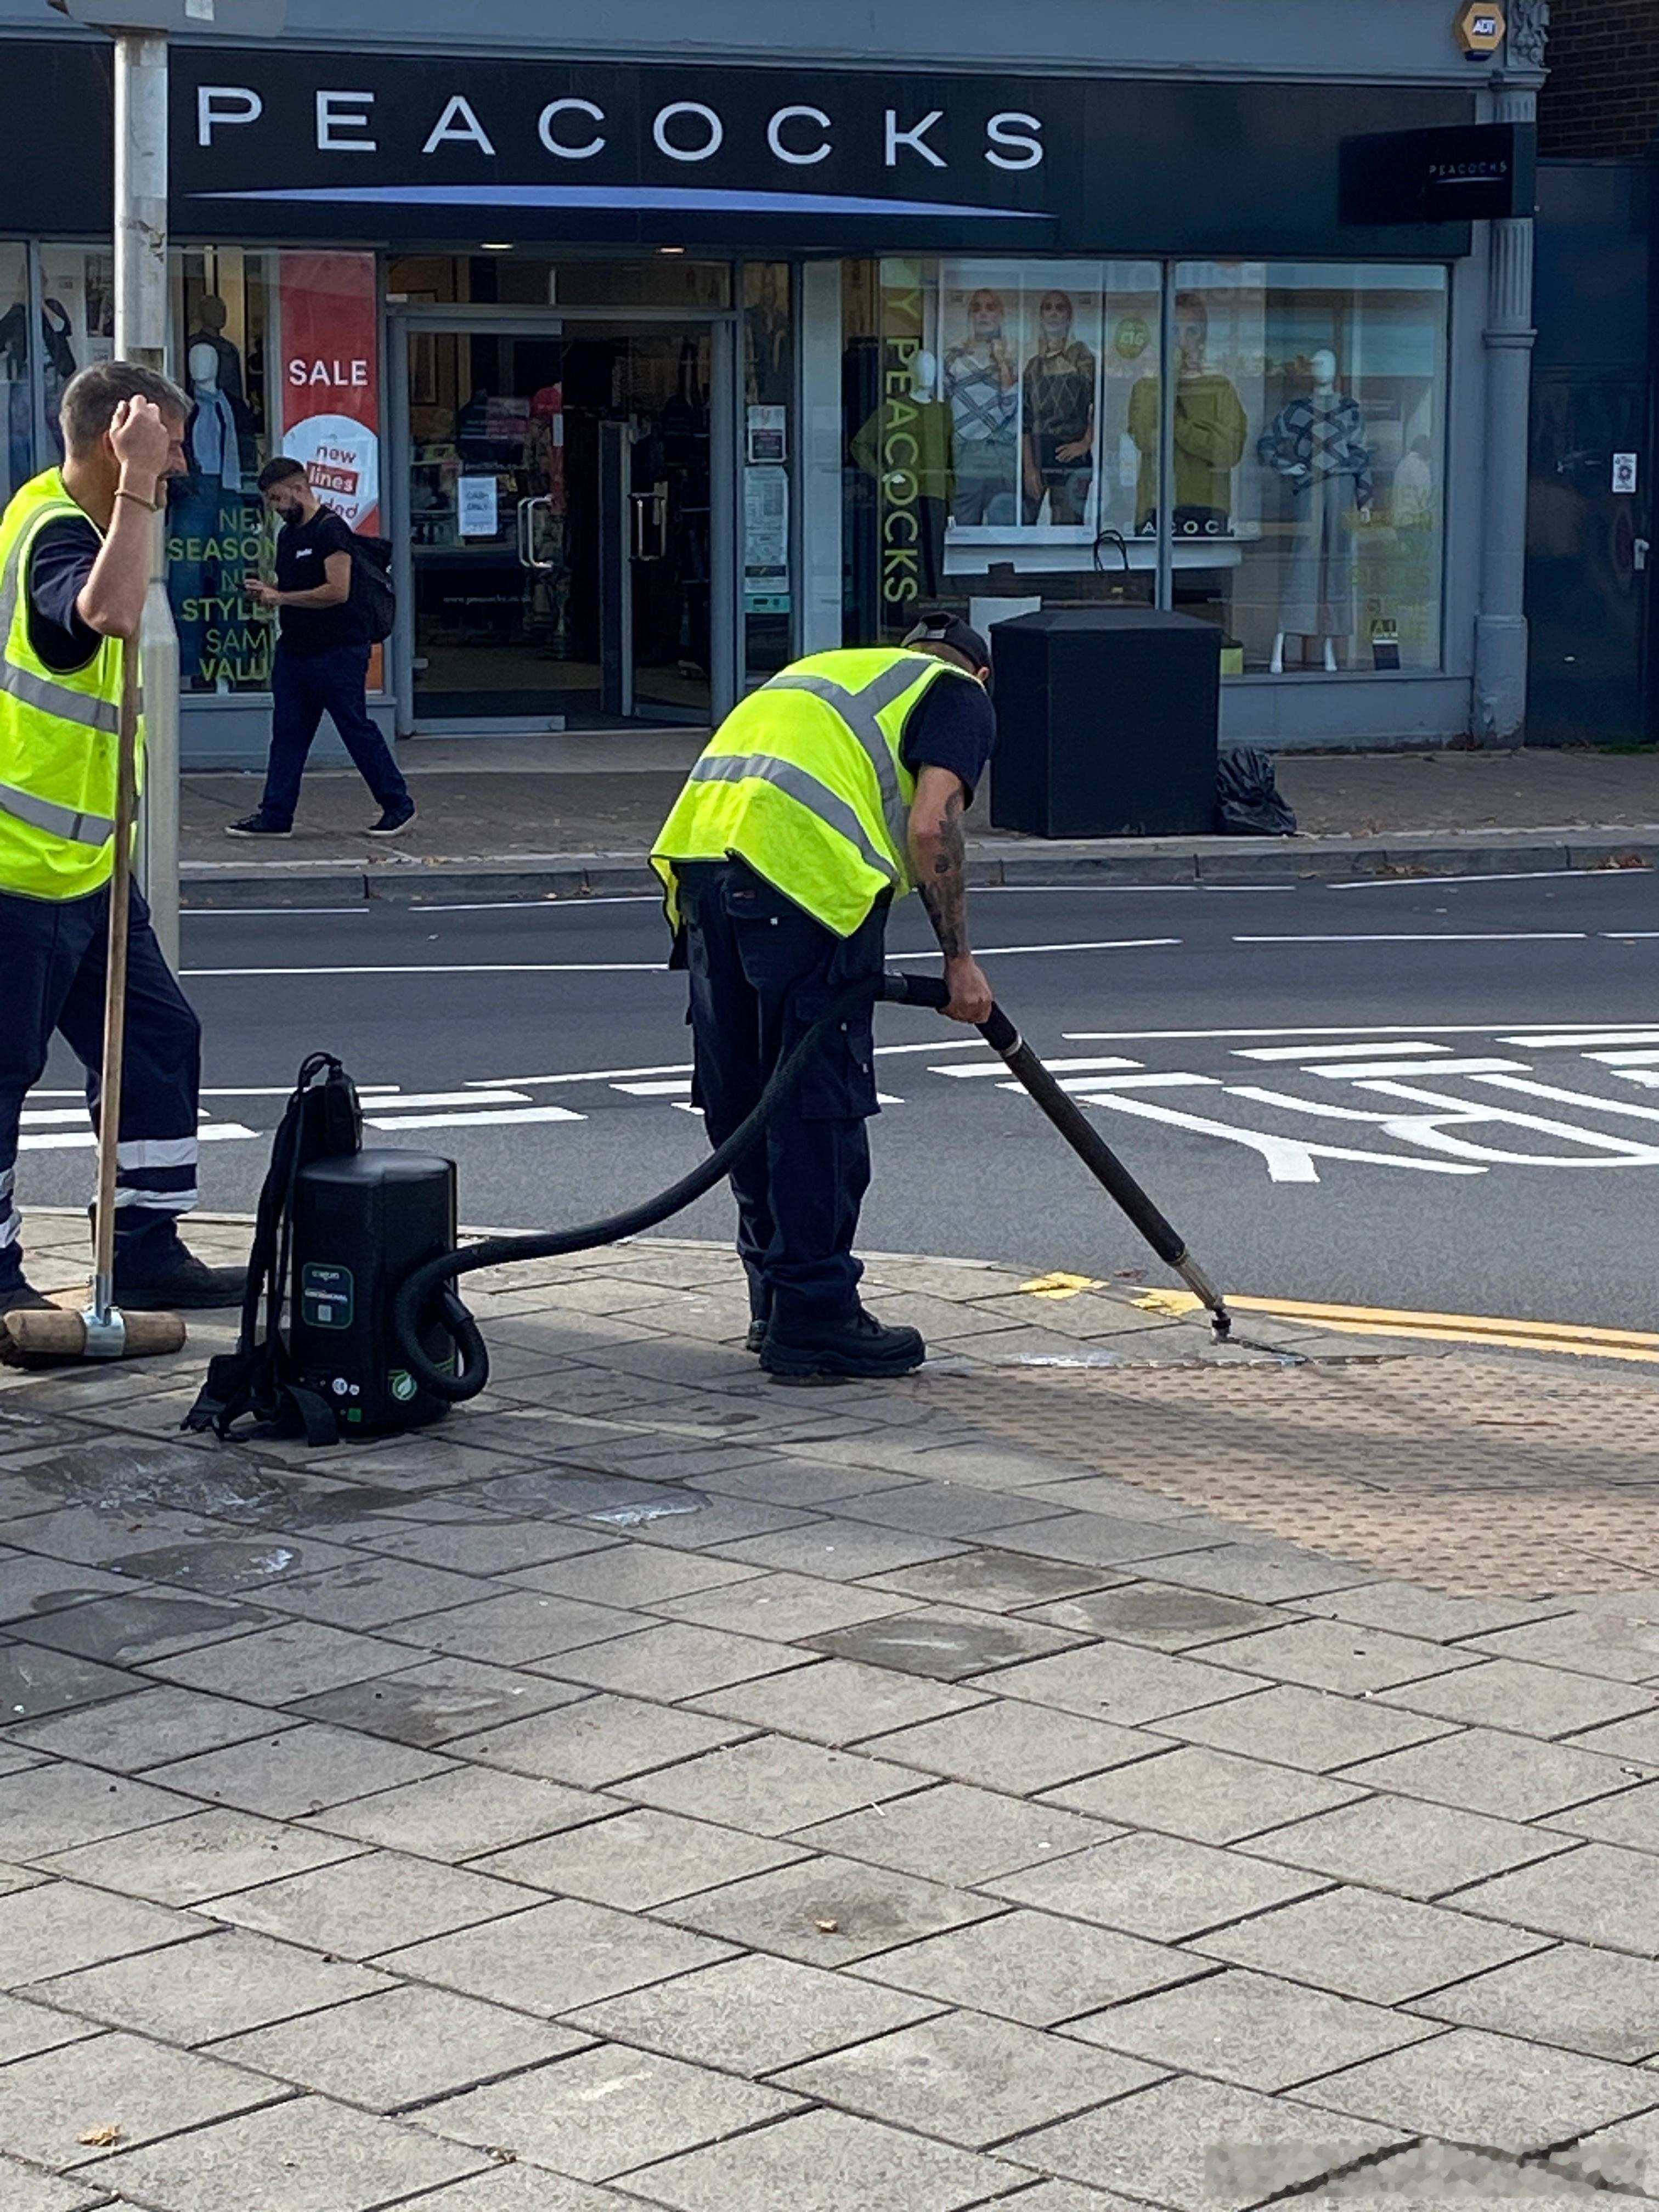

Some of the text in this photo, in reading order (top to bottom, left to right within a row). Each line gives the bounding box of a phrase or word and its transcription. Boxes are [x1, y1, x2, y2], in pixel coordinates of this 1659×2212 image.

[1472, 19, 1494, 33] ADT
[198, 85, 1043, 170] PEACOCKS
[1429, 161, 1507, 176] PEACOCKS
[289, 359, 368, 386] SALE
[317, 444, 356, 464] new
[308, 465, 354, 493] lines
[884, 337, 920, 602] PEACOCKS
[168, 537, 278, 561] SEASON
[182, 597, 274, 622] STYLE
[205, 628, 271, 653] SAM
[199, 658, 271, 681] VALU
